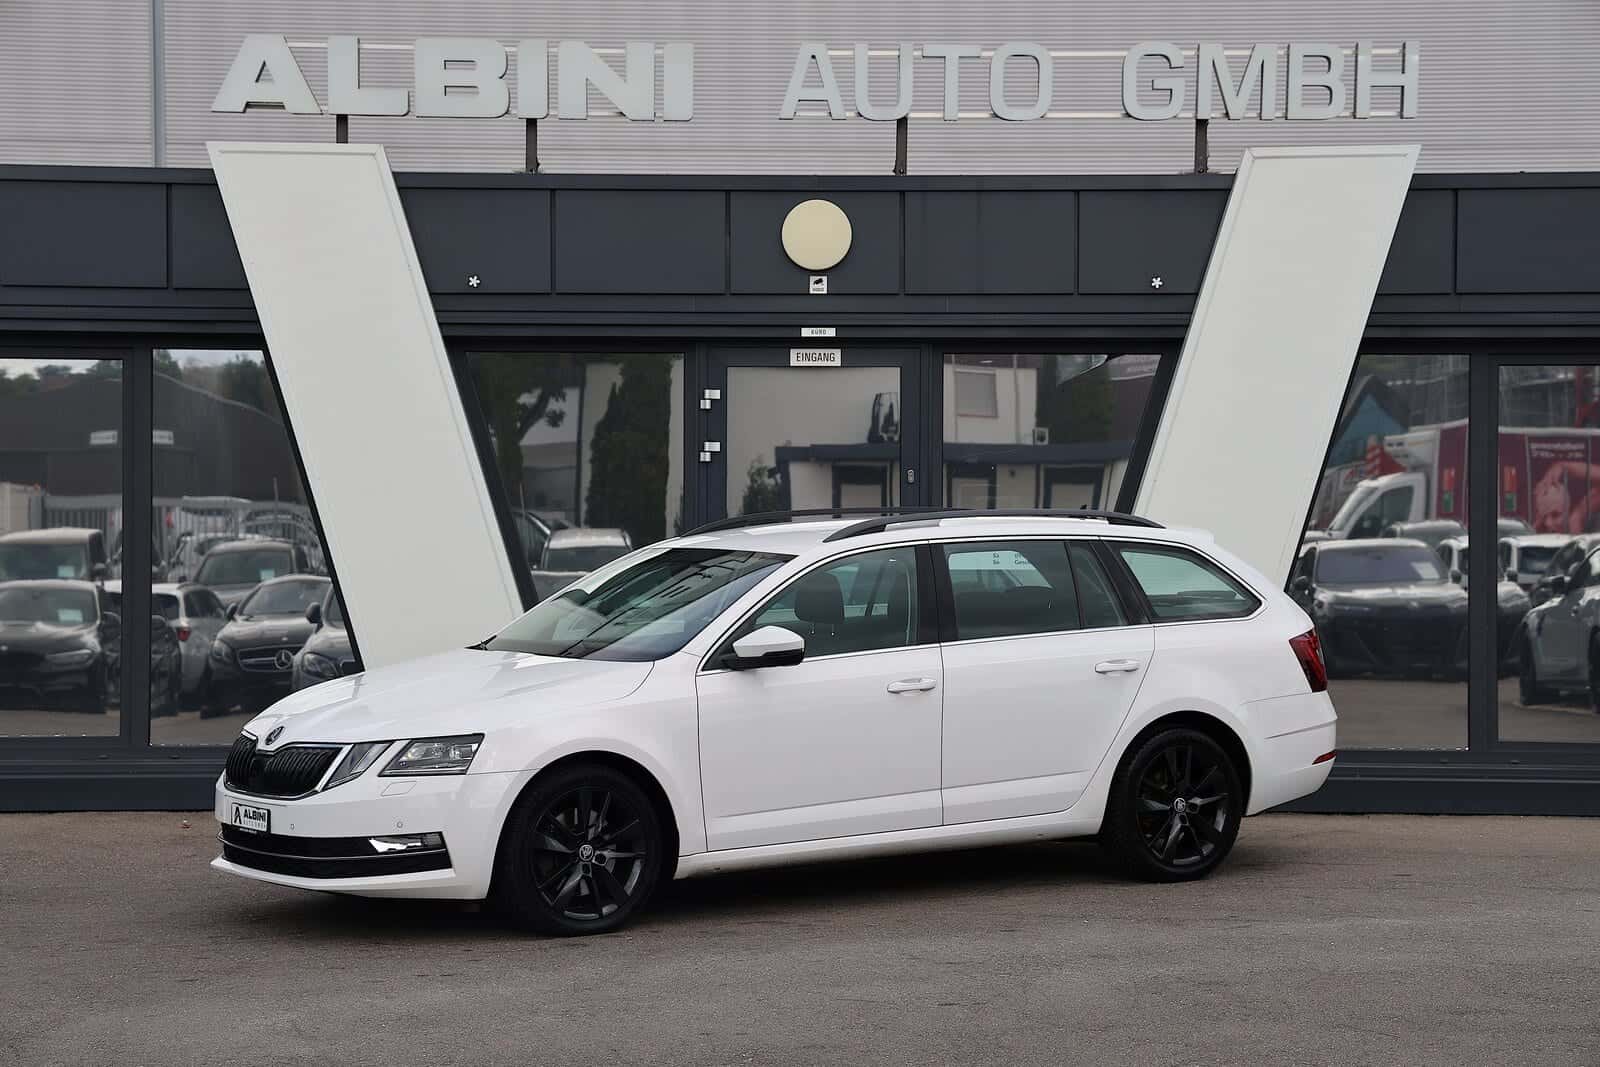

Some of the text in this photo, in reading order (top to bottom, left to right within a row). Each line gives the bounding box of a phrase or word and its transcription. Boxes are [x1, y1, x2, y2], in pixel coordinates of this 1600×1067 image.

[211, 35, 1420, 121] ALBINI AUTO GMBH
[796, 352, 836, 362] EINGANG
[244, 809, 266, 822] ALBINI
